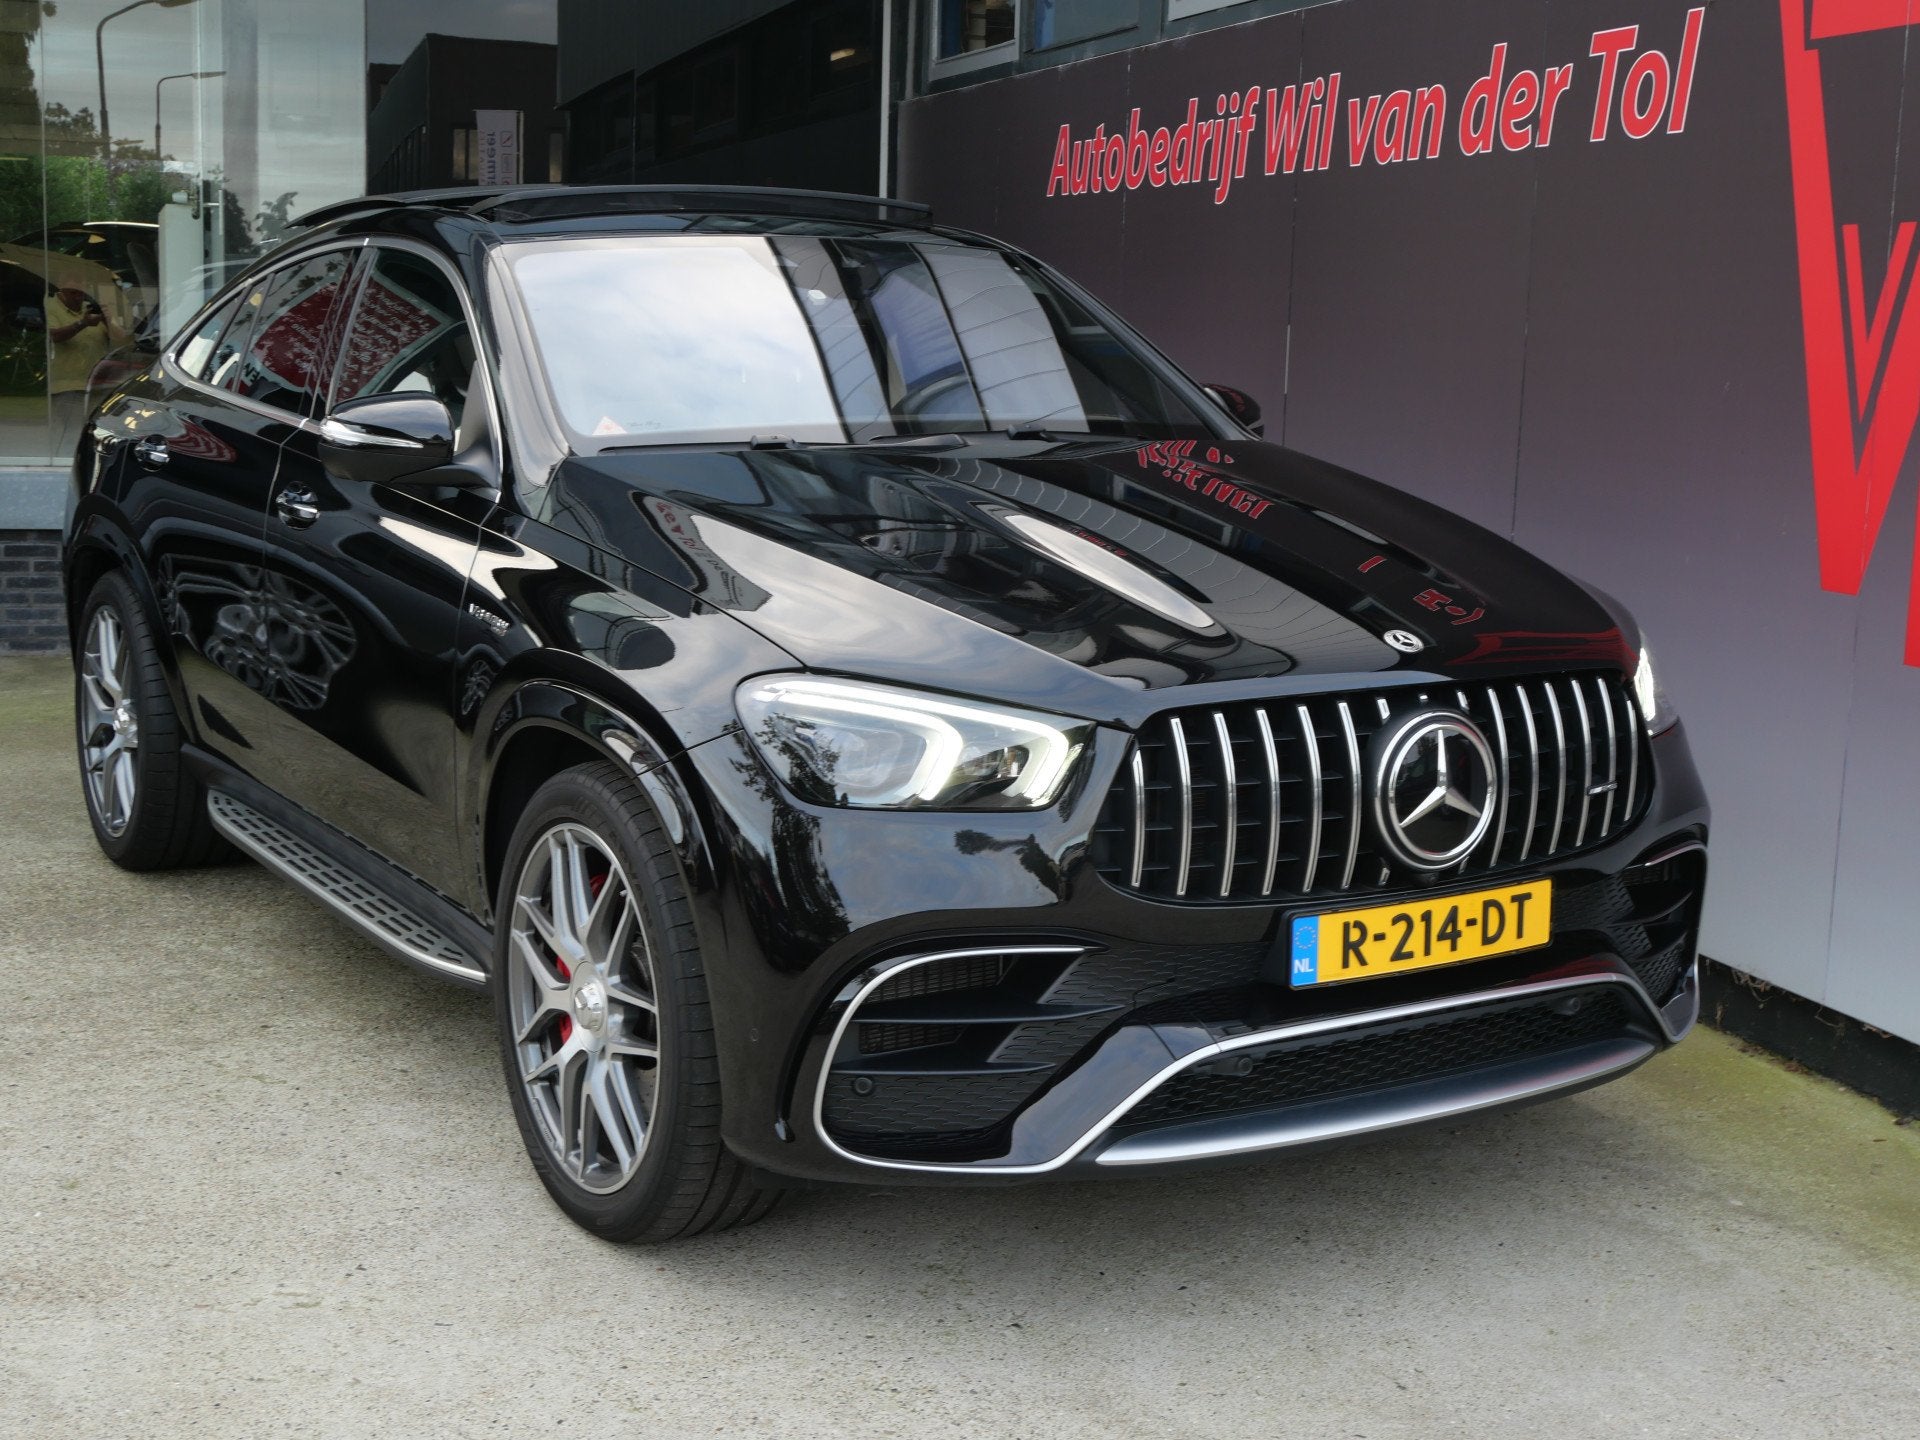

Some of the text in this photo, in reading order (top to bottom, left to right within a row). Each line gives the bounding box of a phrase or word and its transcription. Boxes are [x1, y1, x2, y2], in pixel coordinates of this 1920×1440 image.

[1047, 8, 1704, 204] Autobedrijf Wil van der Tol
[1294, 958, 1314, 974] NL
[1341, 892, 1532, 969] R-214-DT
